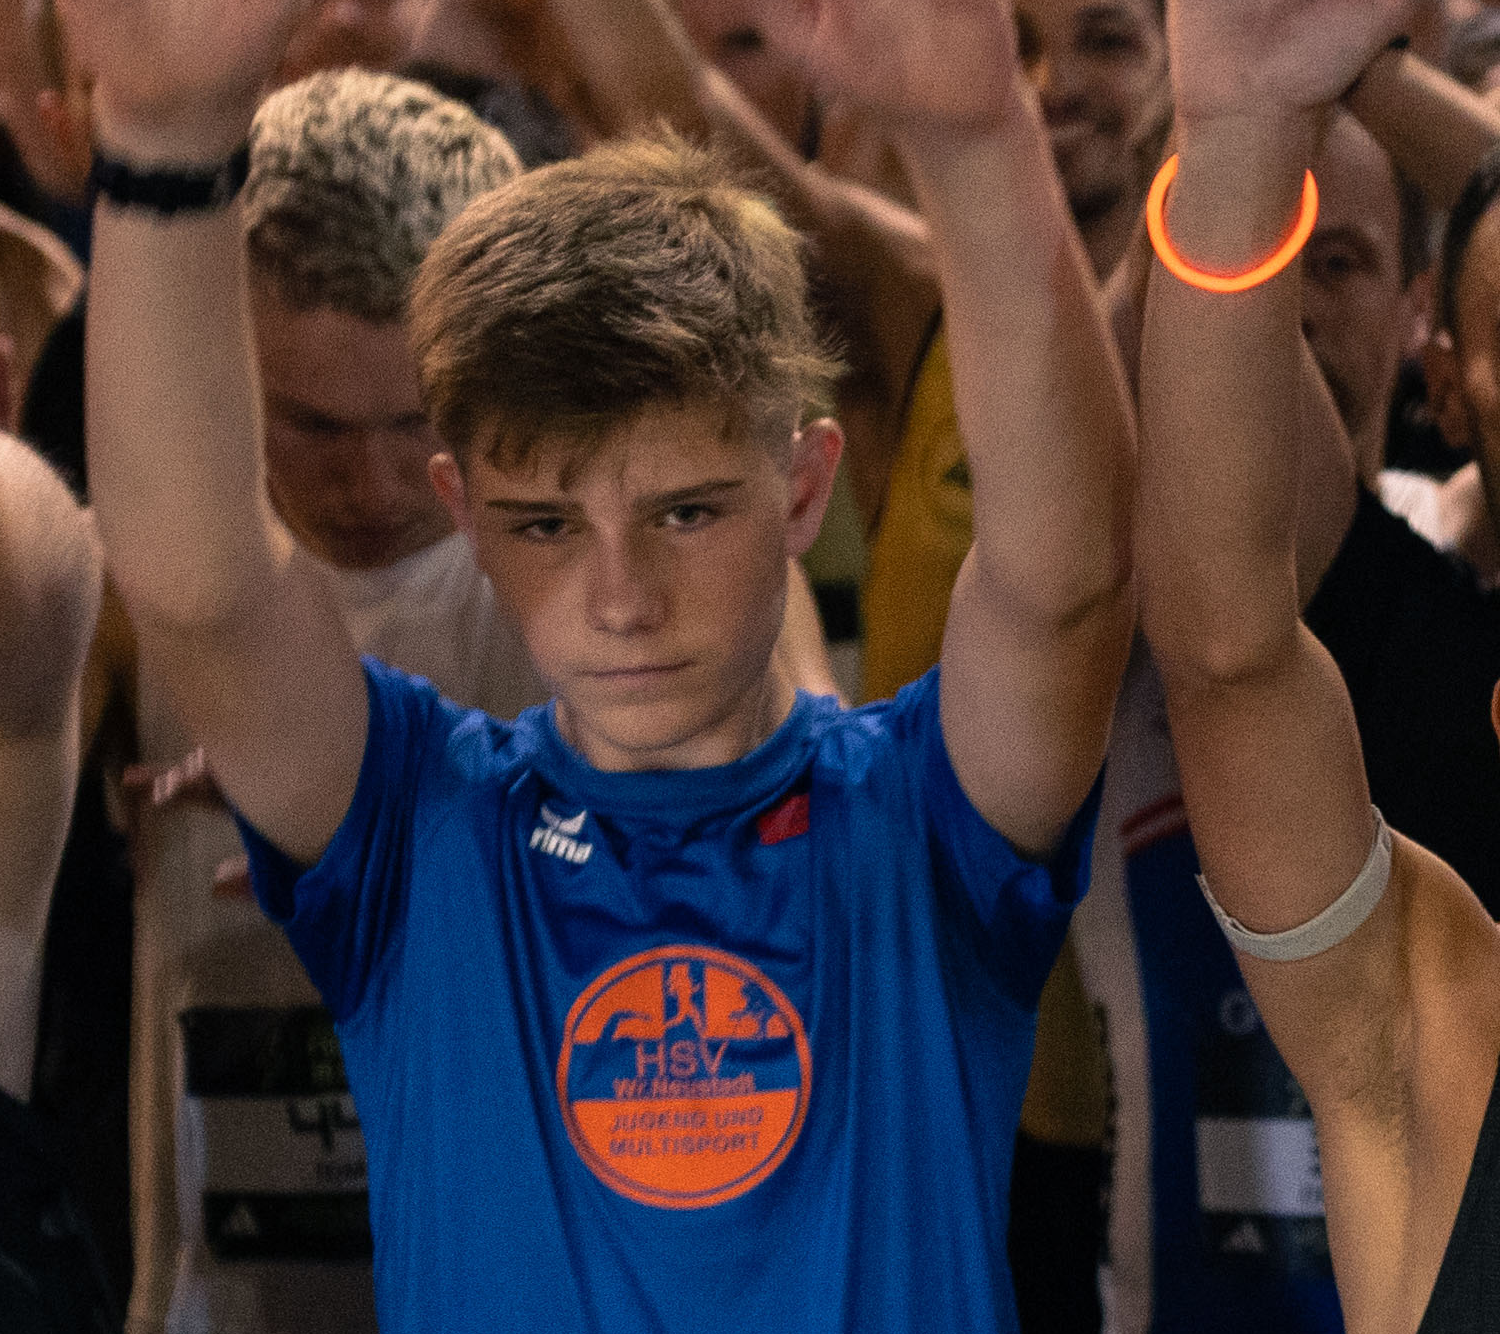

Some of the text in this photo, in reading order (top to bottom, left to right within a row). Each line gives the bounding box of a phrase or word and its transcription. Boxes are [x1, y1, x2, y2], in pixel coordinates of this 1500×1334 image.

[635, 1039, 730, 1078] HSV
[611, 1106, 764, 1133] JUGEND UND
[610, 1132, 760, 1157] MULTISPORT
